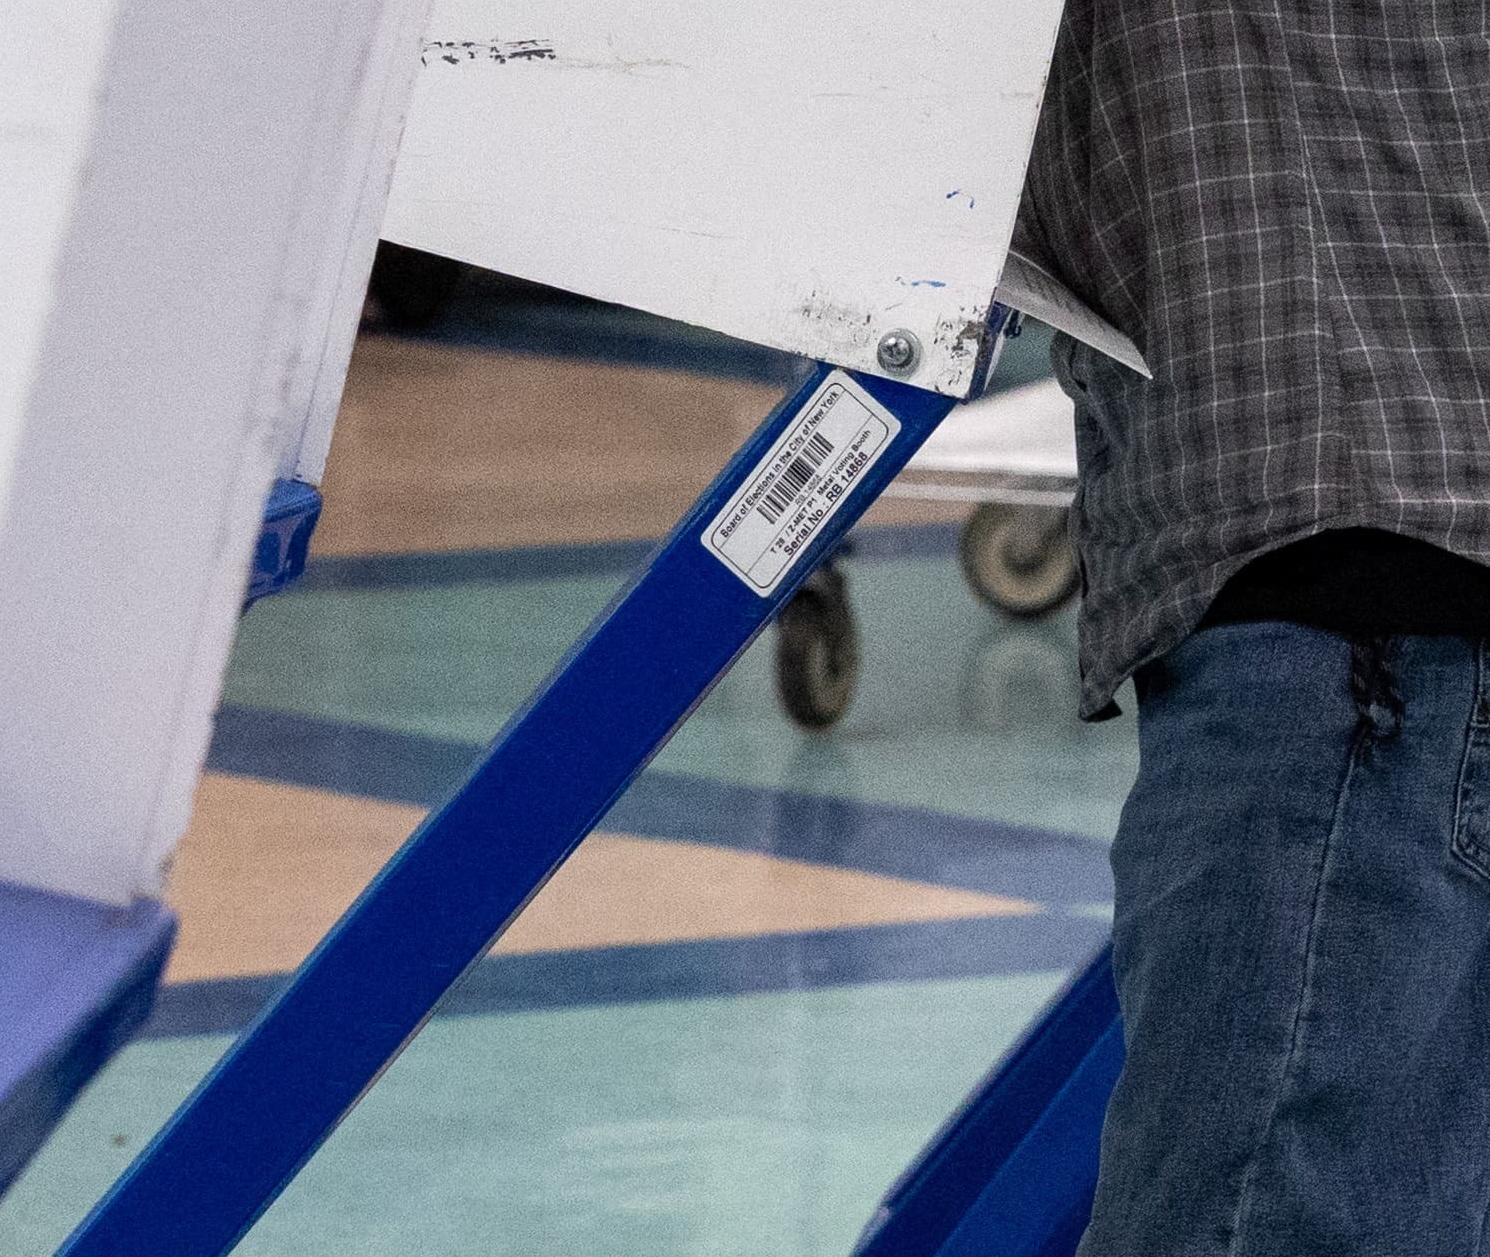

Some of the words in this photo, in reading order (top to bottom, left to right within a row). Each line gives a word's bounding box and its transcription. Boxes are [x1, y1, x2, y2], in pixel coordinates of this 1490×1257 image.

[720, 513, 741, 538] Board
[745, 472, 775, 506] Elections
[789, 435, 805, 451] City
[808, 409, 824, 427] New
[821, 391, 838, 408] York
[784, 523, 811, 555] Serial
[807, 509, 823, 525] No
[826, 484, 842, 502] RB
[841, 451, 867, 482] 14868
